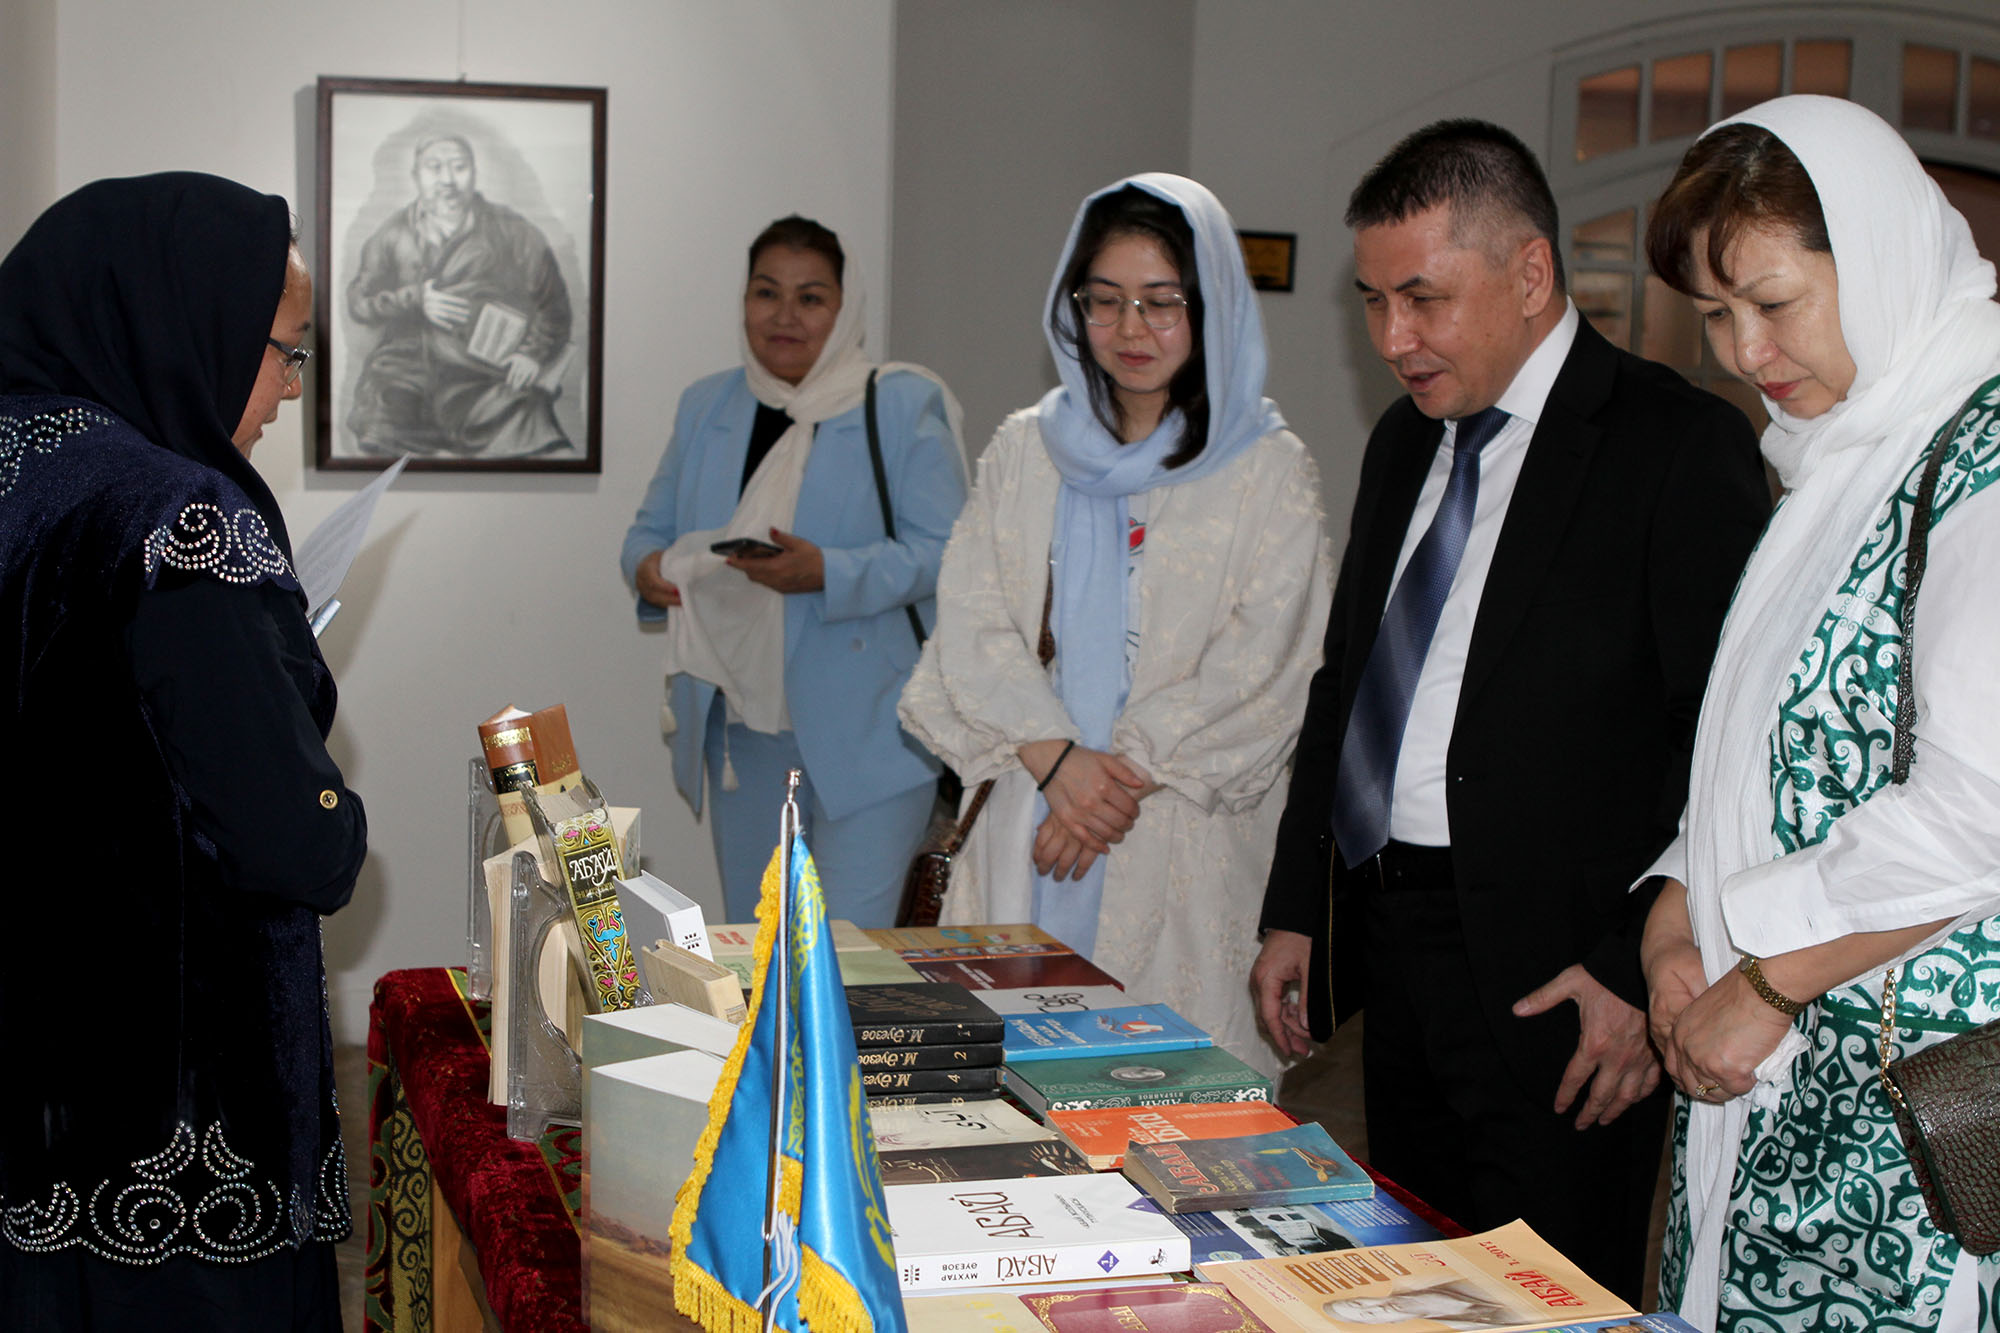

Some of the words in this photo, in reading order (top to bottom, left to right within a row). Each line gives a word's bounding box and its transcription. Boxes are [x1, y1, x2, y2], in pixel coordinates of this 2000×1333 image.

[569, 847, 617, 886] АБАЙ
[954, 1051, 967, 1061] 2
[947, 1073, 960, 1083] 4
[1144, 1143, 1220, 1193] АБАЙ
[947, 1191, 1044, 1238] АБАЙ
[997, 1253, 1058, 1281] АБАЙ
[1504, 1270, 1584, 1307] АБАЙ
